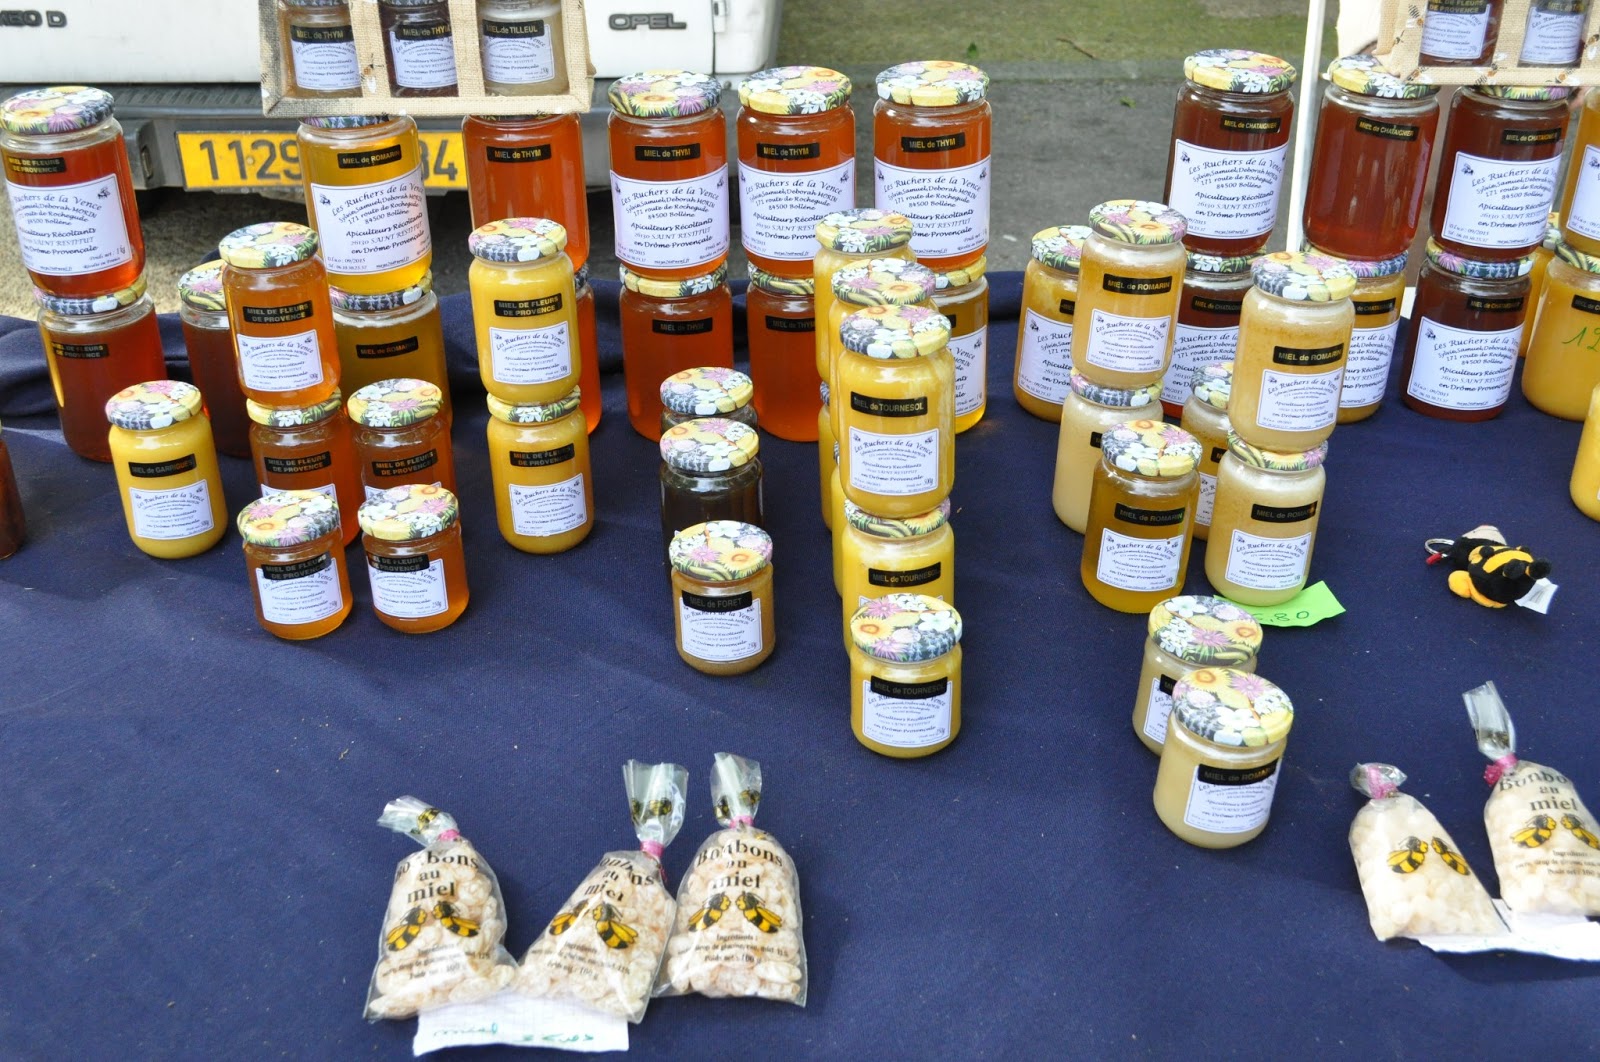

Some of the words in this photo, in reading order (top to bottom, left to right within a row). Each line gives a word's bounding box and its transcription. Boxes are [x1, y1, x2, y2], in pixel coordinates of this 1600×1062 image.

[46, 10, 67, 28] D
[608, 13, 687, 30] OPEL
[510, 25, 537, 34] TILLEUL
[937, 139, 955, 147] THYM
[371, 150, 400, 161] ROMARIN
[521, 150, 541, 158] THYM
[764, 147, 778, 155] MIEL
[1189, 165, 1200, 175] Les
[1203, 158, 1243, 170] Ruchers
[1246, 157, 1256, 165] de
[1258, 158, 1266, 166] la
[1472, 177, 1485, 187] Les
[1488, 169, 1529, 181] Ruchers
[755, 180, 789, 189] Ruchers
[821, 181, 842, 194] Vence
[884, 184, 893, 192] Les
[894, 176, 931, 187] Ruchers
[935, 175, 945, 183] de
[949, 176, 957, 184] la
[962, 178, 981, 191] Vence
[332, 206, 344, 217] Les
[345, 190, 384, 208] Ruchers
[387, 185, 397, 194] de
[621, 197, 631, 206] Les
[632, 188, 668, 199] Ruchers
[672, 186, 683, 194] de
[700, 188, 719, 200] Vence
[936, 194, 970, 203] Rochegude
[1195, 192, 1240, 201] Apiculteurs
[74, 196, 102, 211] Vence
[795, 197, 830, 206] Rochegude
[674, 205, 708, 213] Rochegude
[1478, 203, 1524, 211] Apiculteurs
[48, 211, 88, 222] Rochegude
[361, 209, 379, 217] route
[754, 212, 793, 223] Apiculteurs
[1207, 210, 1234, 218] Drôme
[365, 214, 385, 224] 84500
[1490, 220, 1517, 228] Drôme
[346, 226, 392, 238] Apiculteurs
[631, 223, 673, 231] Apiculteurs
[931, 227, 972, 237] Provençale
[672, 236, 712, 248] Provençale
[52, 246, 98, 254] Provençale
[1108, 280, 1124, 288] MIEL
[1138, 282, 1170, 290] ROMARIN
[531, 297, 559, 307] FLEURS
[280, 304, 308, 313] FLEURS
[516, 305, 555, 315] PROVENCE
[264, 312, 305, 322] PROVENCE
[505, 335, 530, 344] Ruchers
[1180, 334, 1217, 343] Ruchers
[1434, 342, 1447, 351] Les
[1449, 338, 1488, 347] Ruchers
[1491, 336, 1501, 344] de
[1279, 352, 1297, 360] MIEL
[1311, 349, 1341, 360] ROMARIN
[1440, 366, 1482, 377] Apiculteurs
[1450, 383, 1476, 391] Drôme
[879, 403, 923, 411] TOURNESOL
[863, 440, 892, 448] Ruchers
[298, 455, 326, 464] FLEURS
[284, 462, 323, 472] PROVENCE
[1120, 510, 1137, 519] MIEL
[1150, 513, 1183, 521] ROMARIN
[1257, 510, 1274, 518] MIEL
[1539, 786, 1559, 794] au
[1530, 798, 1578, 811] miel
[420, 870, 440, 881] au
[712, 873, 760, 889] miel
[408, 882, 455, 903] miel
